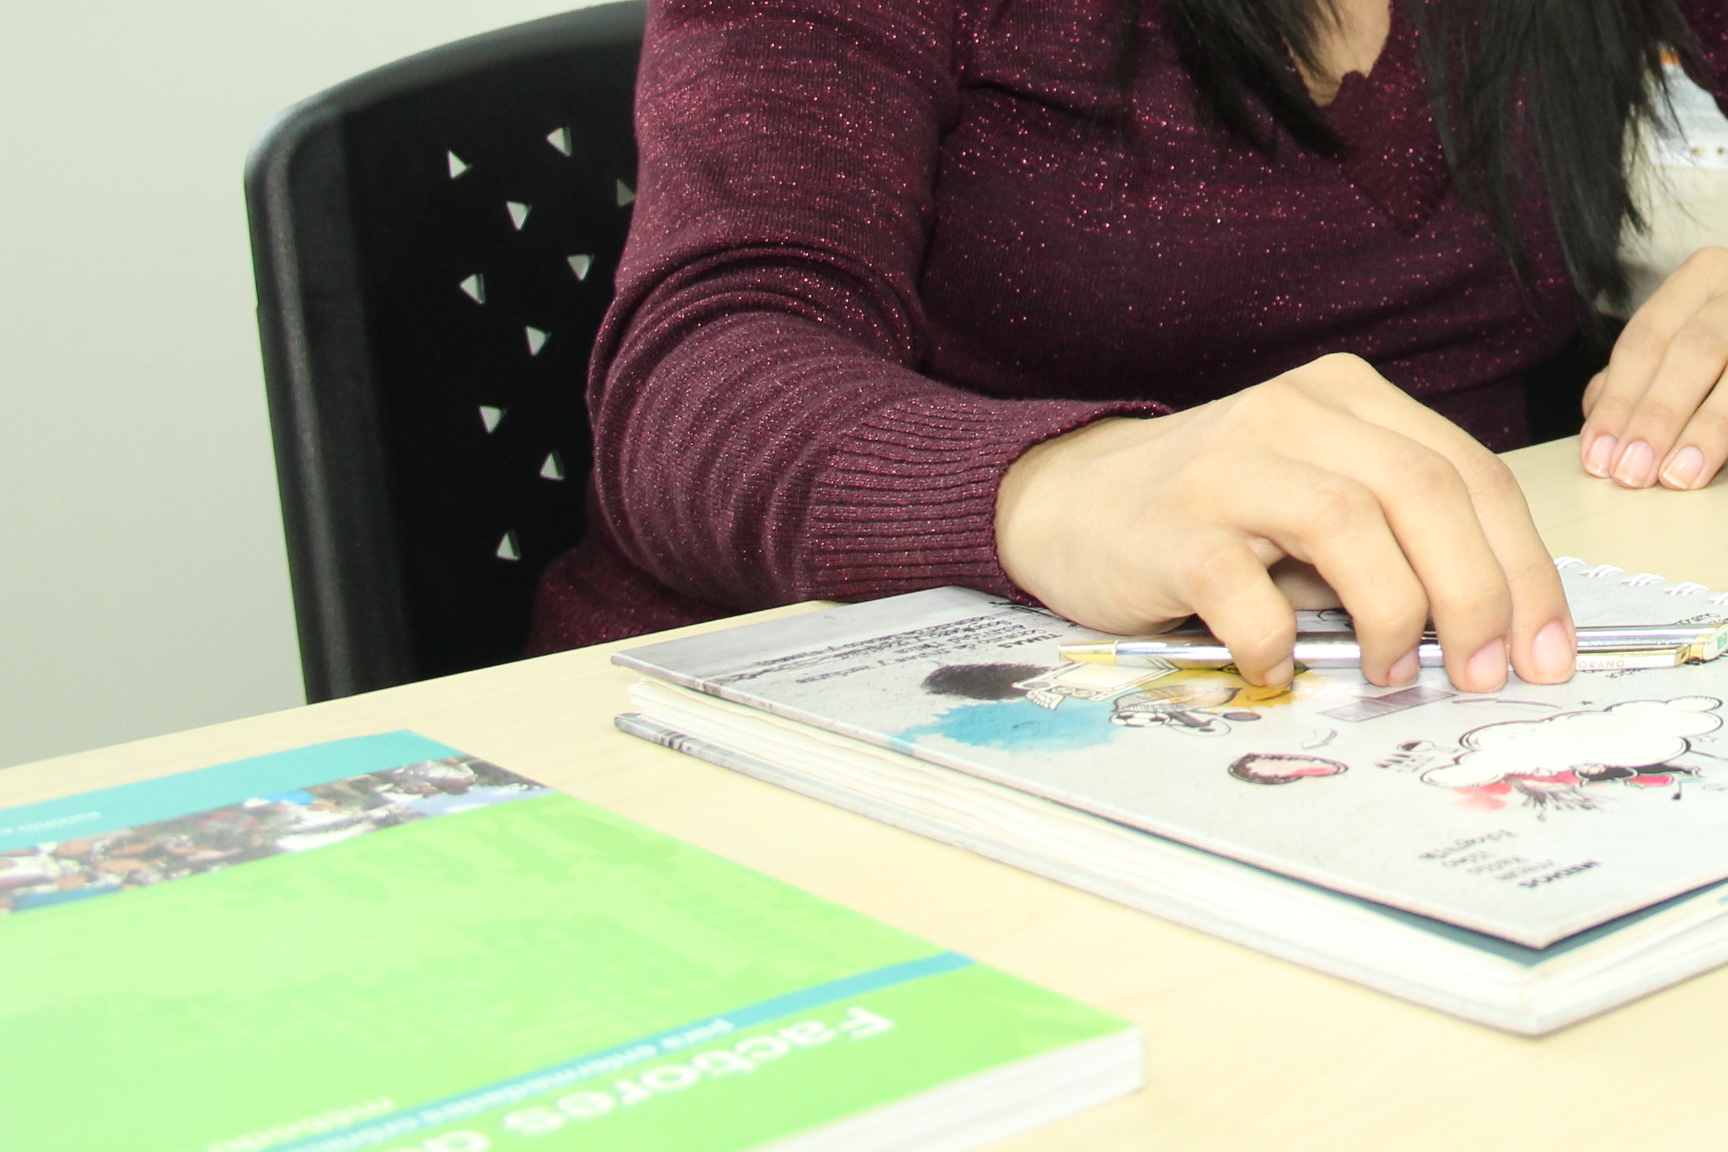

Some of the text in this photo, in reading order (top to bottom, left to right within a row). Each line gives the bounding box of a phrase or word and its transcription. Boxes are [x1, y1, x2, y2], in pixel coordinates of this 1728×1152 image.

[994, 632, 1063, 649] TEMAS
[419, 1016, 737, 1126] para enfermedades
[501, 1004, 898, 1138] Factores
